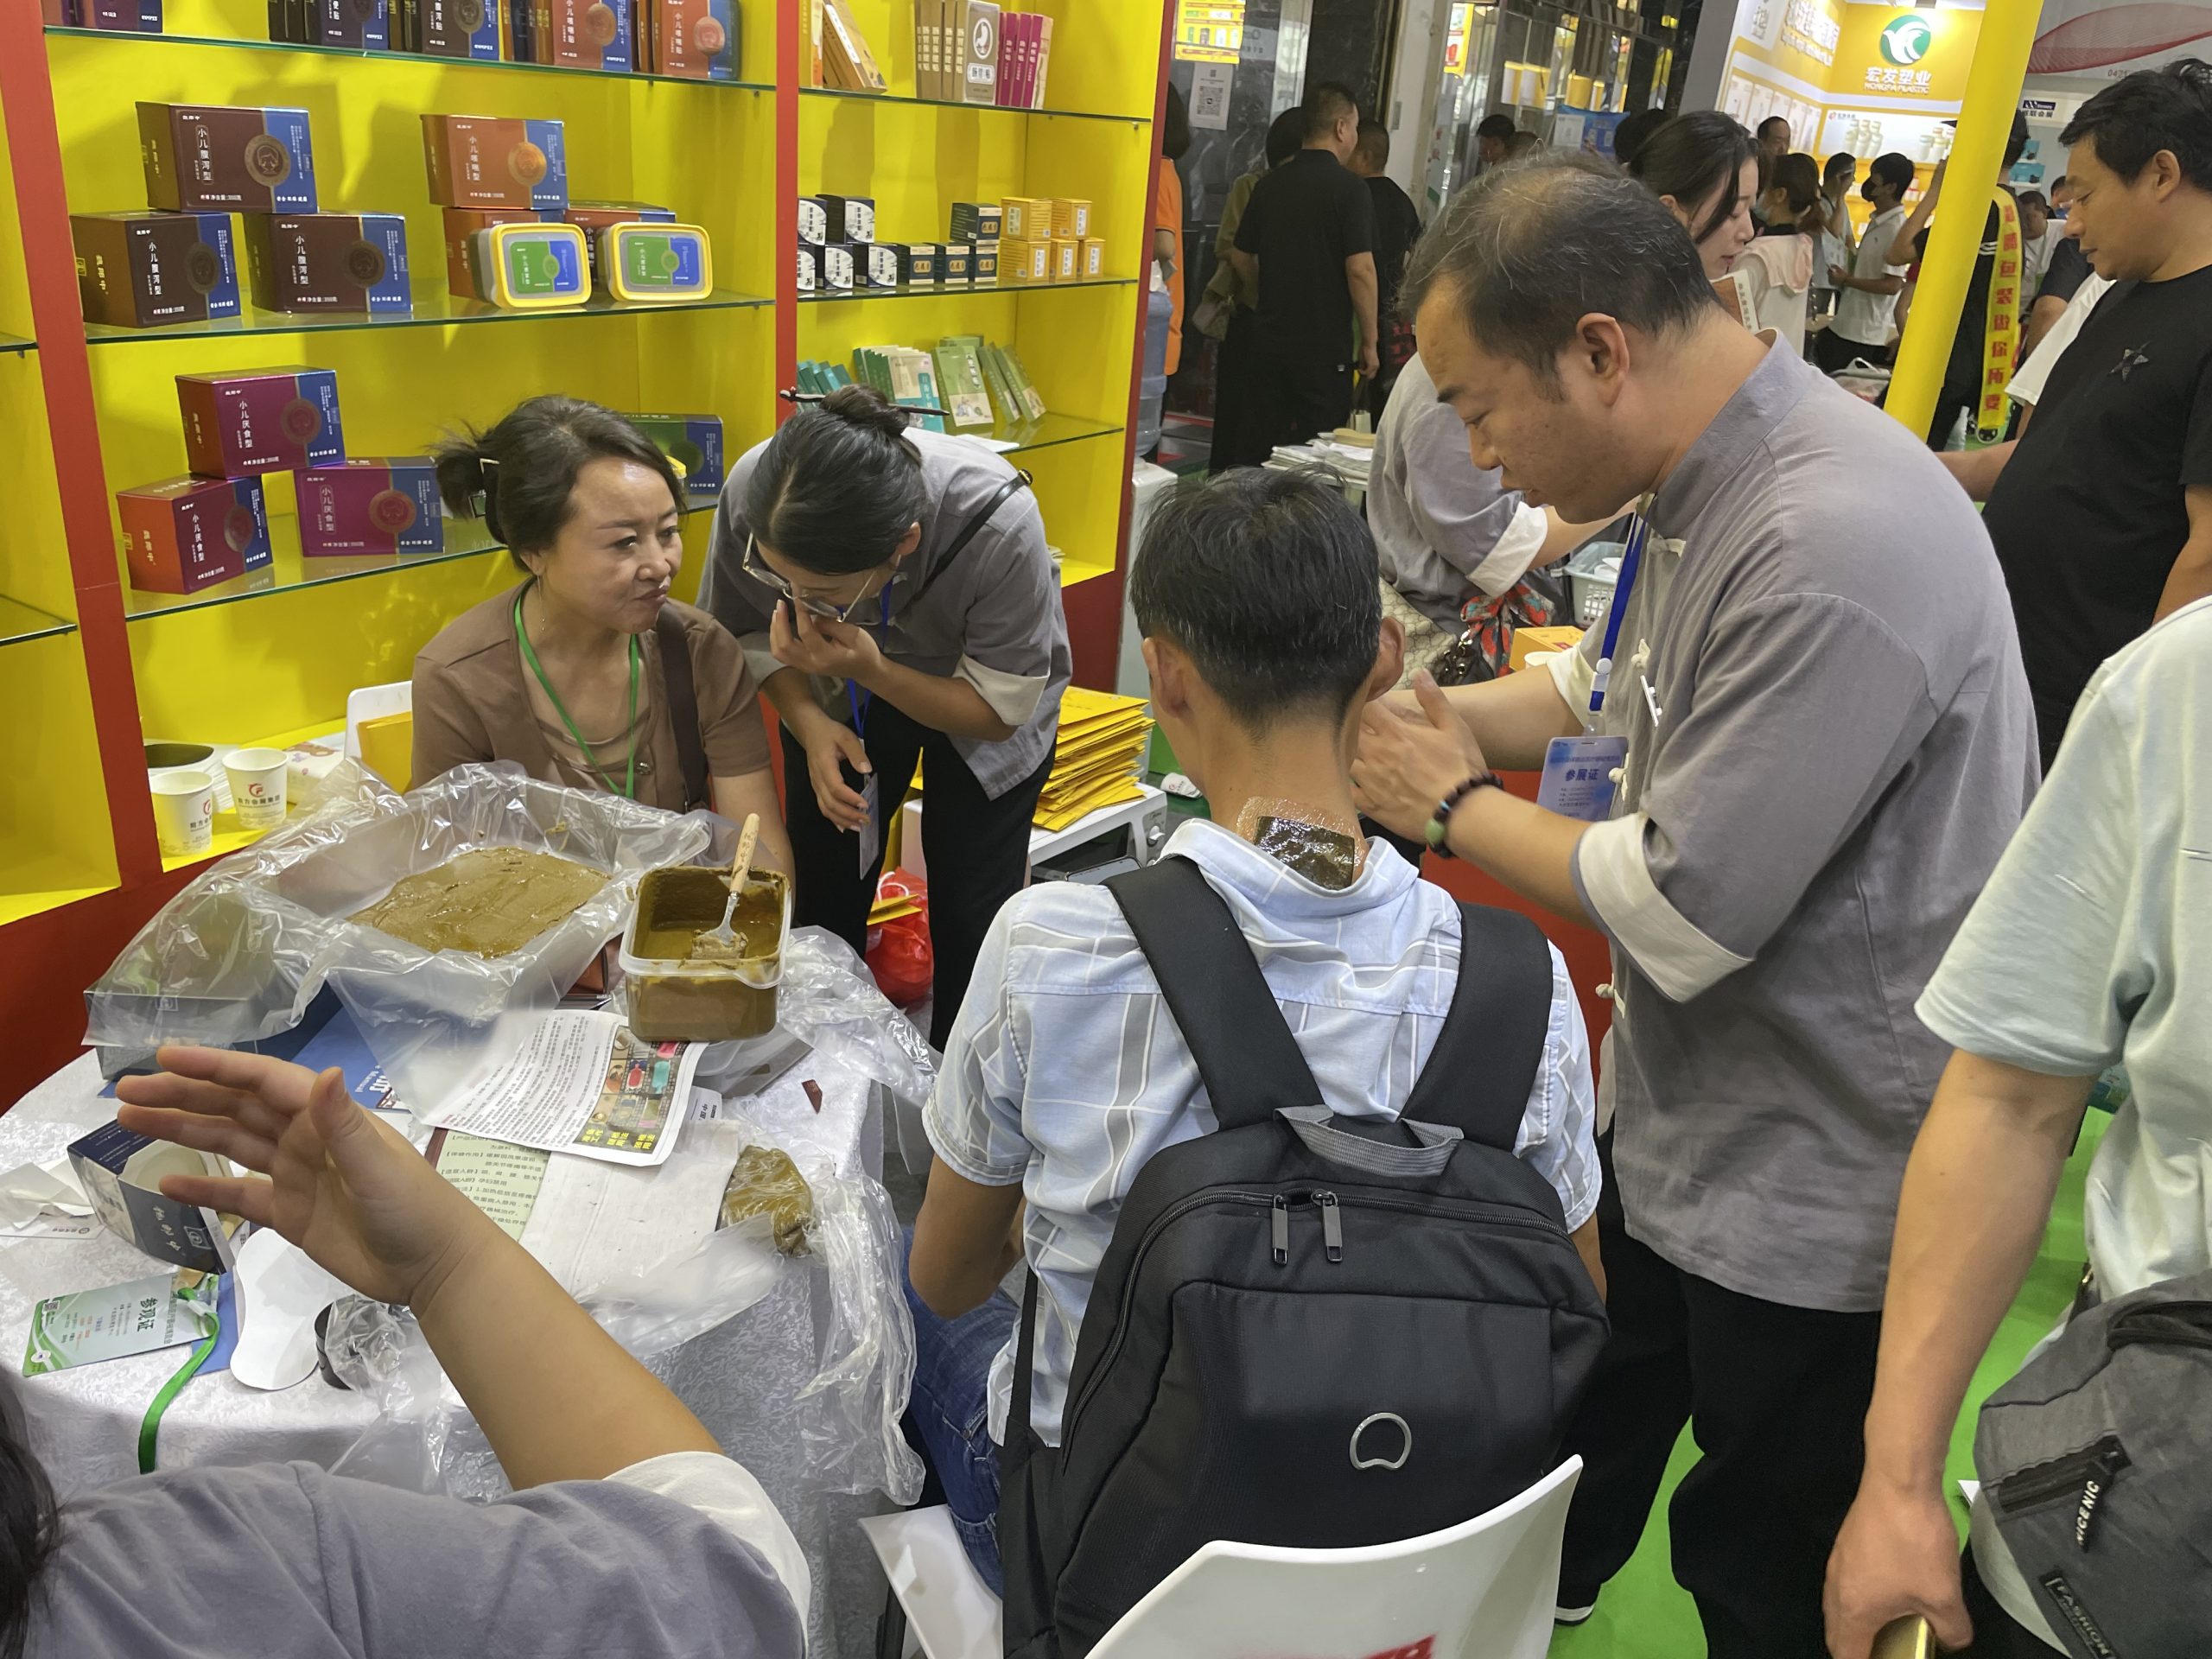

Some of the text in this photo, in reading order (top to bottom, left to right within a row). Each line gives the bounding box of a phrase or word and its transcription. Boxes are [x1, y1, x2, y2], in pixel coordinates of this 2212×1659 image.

[1866, 67, 1932, 86] 宏发塑业
[1565, 768, 1599, 782] 参展证
[136, 1297, 158, 1332] 参观证
